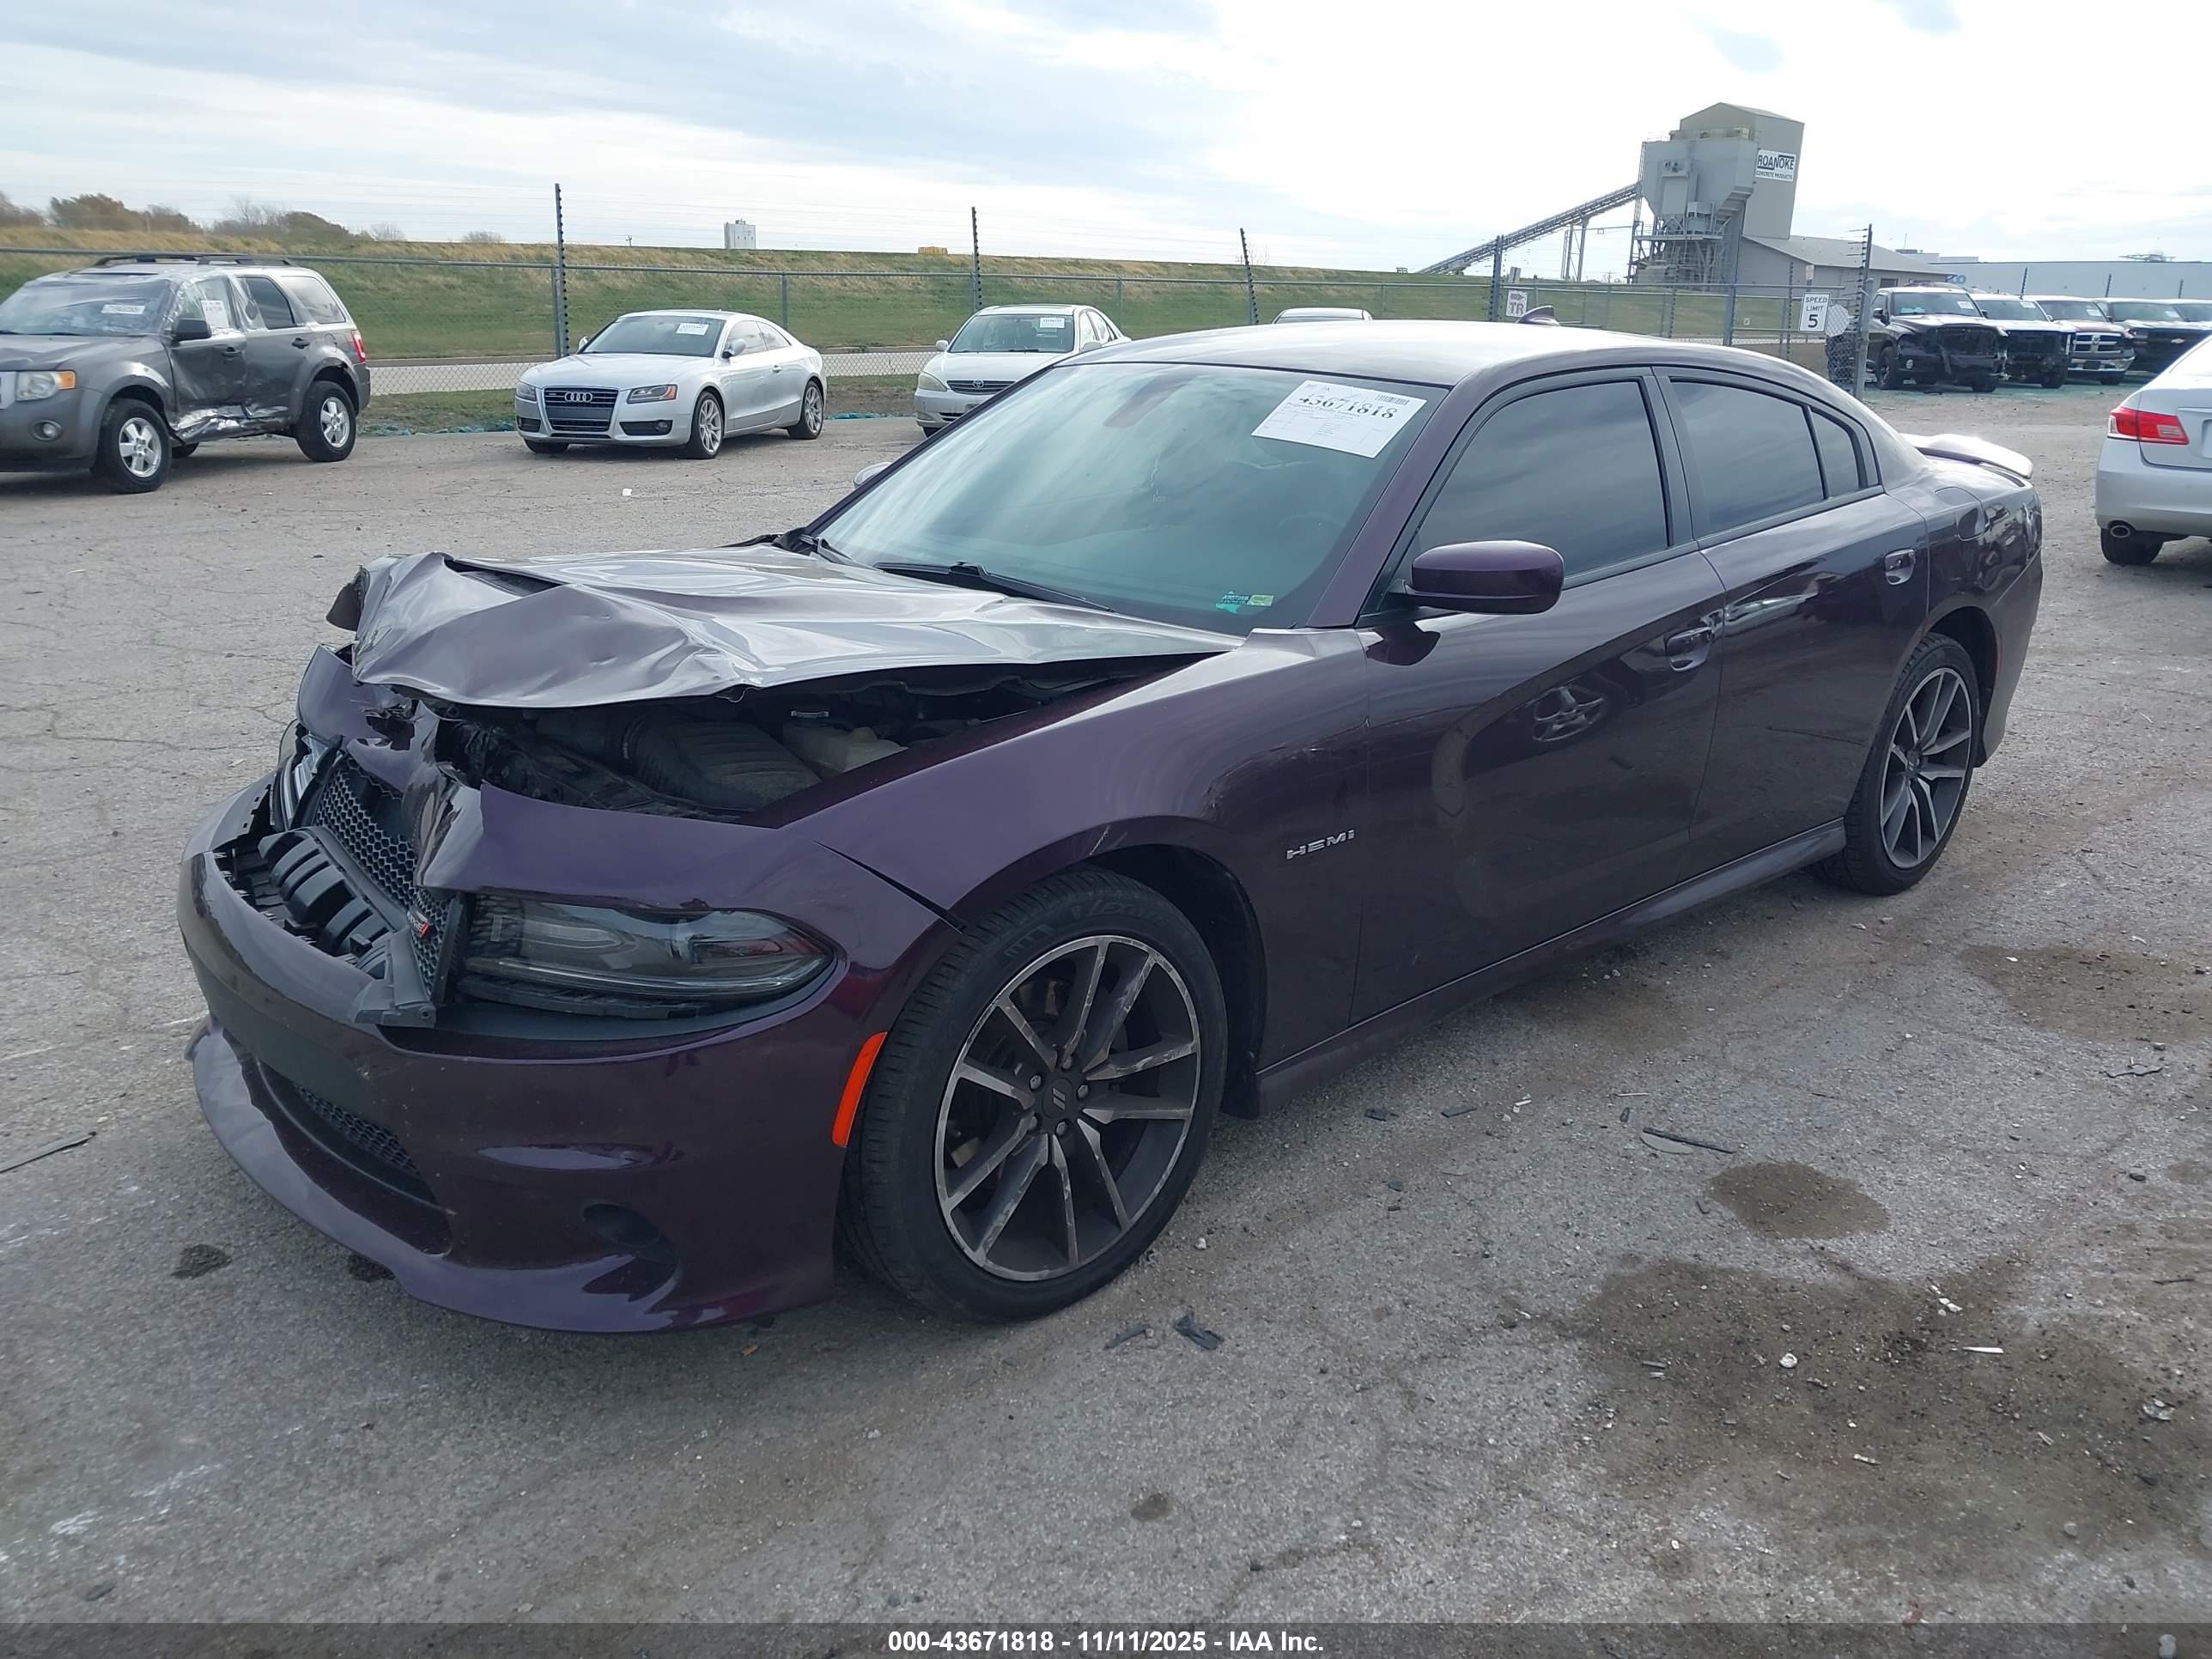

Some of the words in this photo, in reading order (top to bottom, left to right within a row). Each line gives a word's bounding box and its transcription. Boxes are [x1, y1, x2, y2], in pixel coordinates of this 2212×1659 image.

[1757, 155, 1795, 170] ROANOKE
[1808, 313, 1819, 328] 5
[1286, 829, 1355, 860] HEMI
